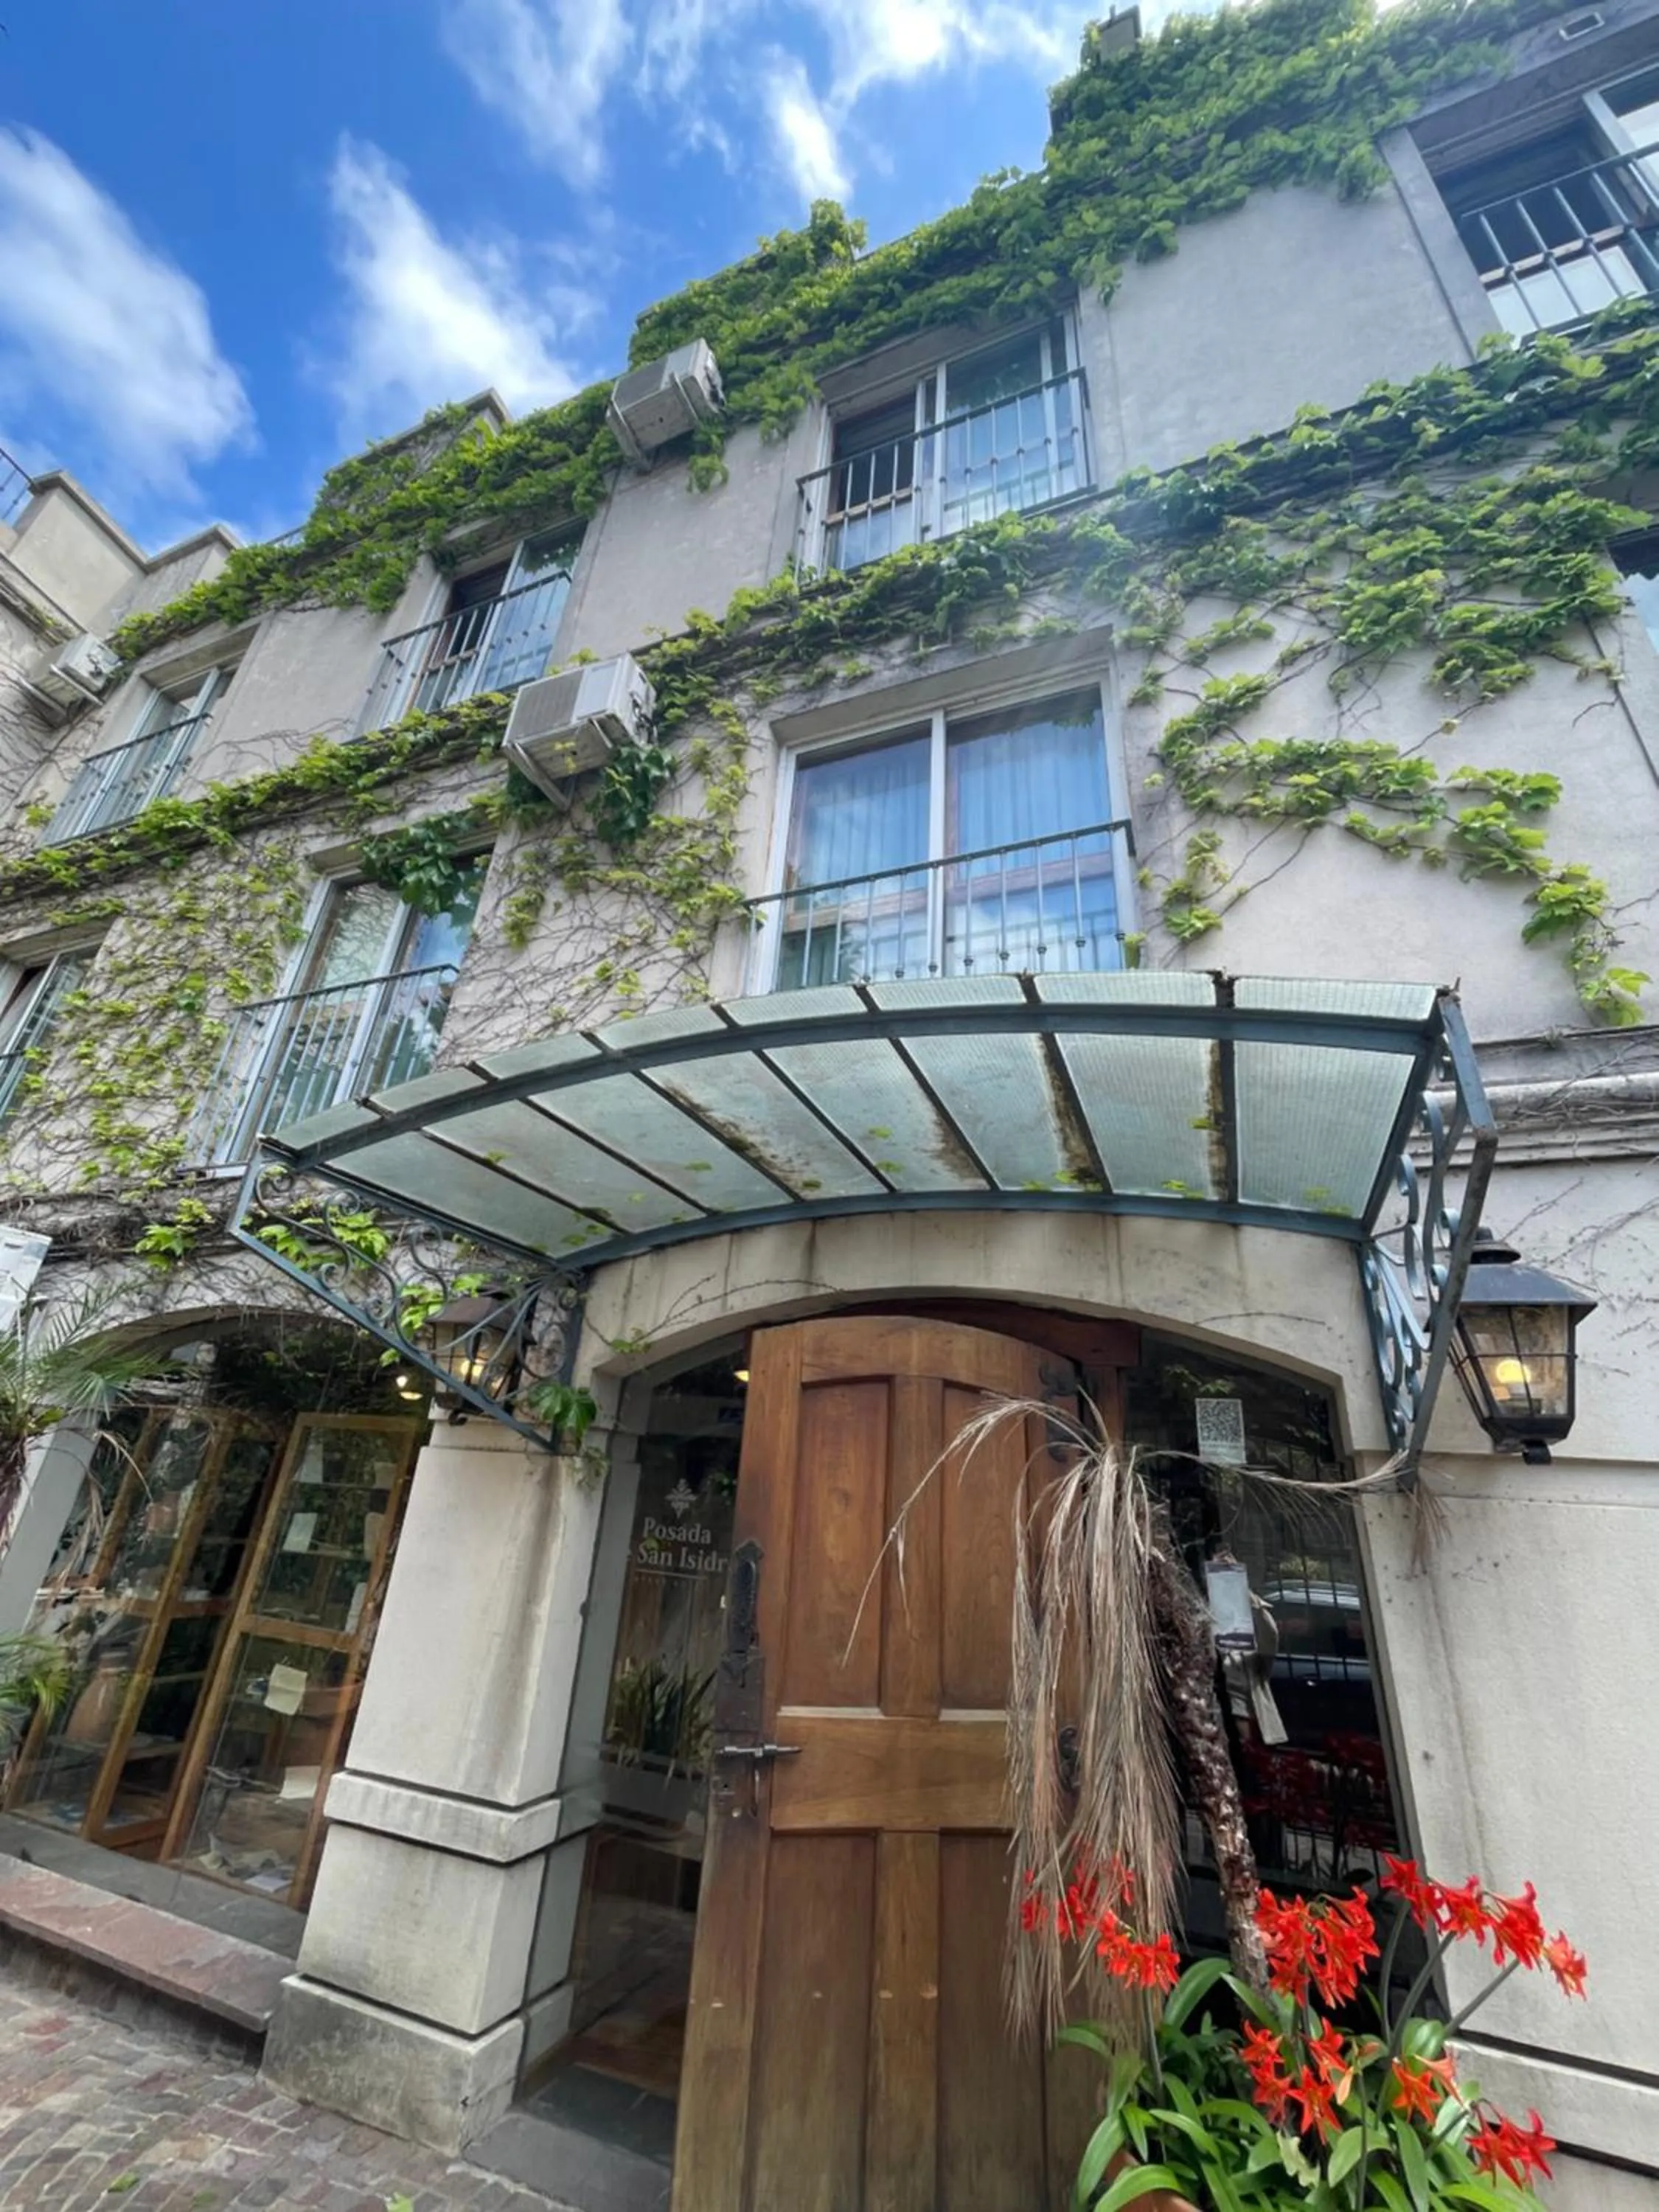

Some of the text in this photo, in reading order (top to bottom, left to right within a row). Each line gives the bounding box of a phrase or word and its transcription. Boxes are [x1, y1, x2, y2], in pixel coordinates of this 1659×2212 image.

[643, 1517, 712, 1545] Posada
[637, 1543, 729, 1572] San Isidr
